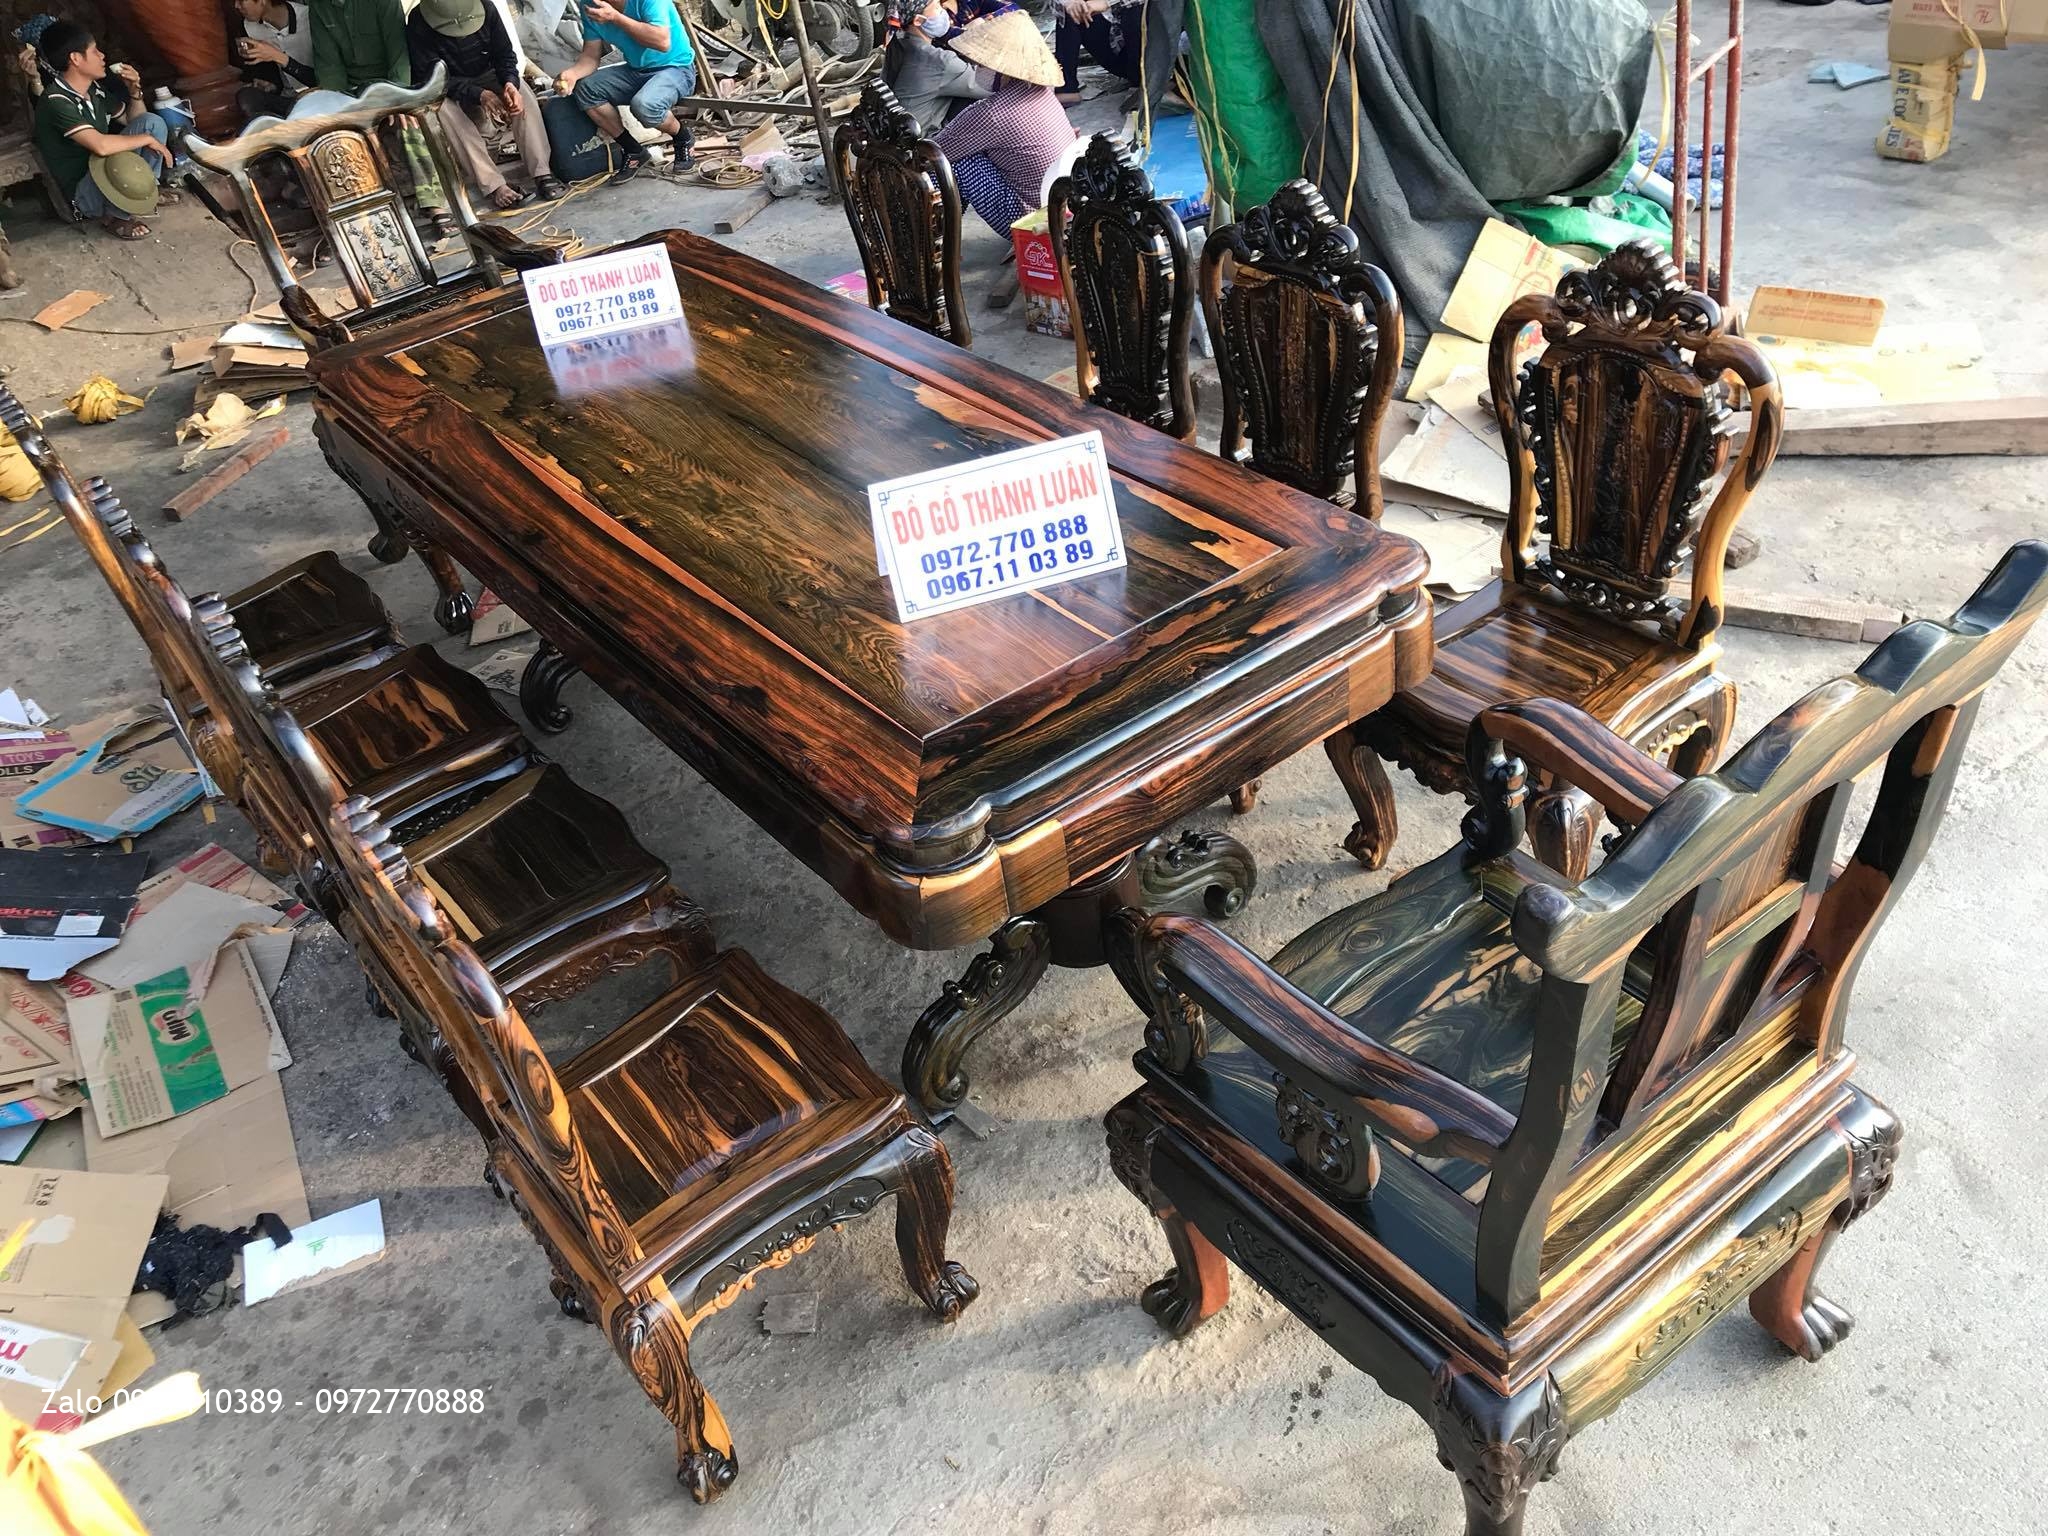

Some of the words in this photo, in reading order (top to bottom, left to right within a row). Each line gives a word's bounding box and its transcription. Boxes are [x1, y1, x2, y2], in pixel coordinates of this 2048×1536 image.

[556, 295, 624, 319] 0972.770
[628, 288, 656, 303] 888
[559, 311, 614, 333] 0967.11
[620, 305, 638, 320] 03
[643, 302, 659, 315] 89
[921, 528, 1035, 574] 0972.770
[1043, 514, 1088, 543] 888
[927, 558, 1019, 599] 0967.11
[1028, 548, 1058, 573] 03
[1066, 540, 1094, 564] 89
